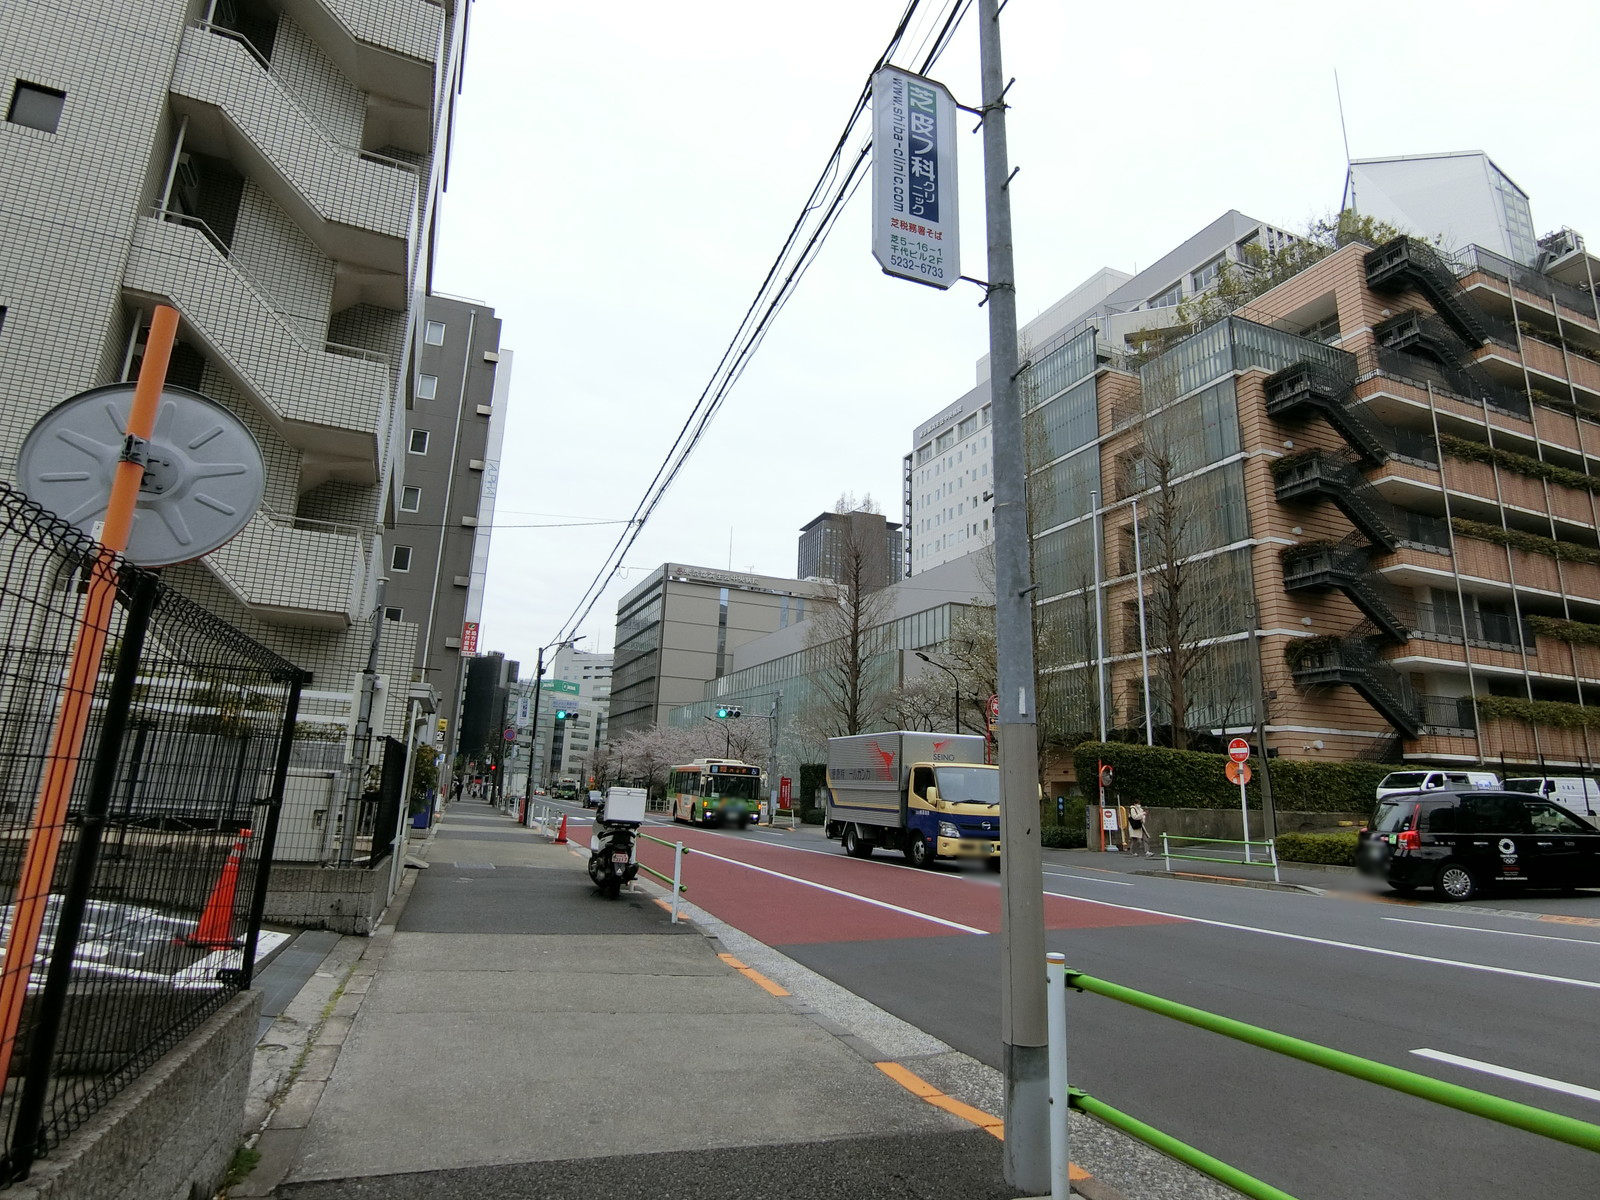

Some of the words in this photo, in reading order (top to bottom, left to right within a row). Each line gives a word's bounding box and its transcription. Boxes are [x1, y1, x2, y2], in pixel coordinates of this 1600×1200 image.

[893, 77, 906, 212] www.shiba-clinic.com
[909, 86, 936, 181] 芝皮フ科
[890, 217, 943, 241] 芝税務署そば
[890, 244, 943, 266] 千代ビル2F
[890, 254, 944, 279] 5232-6733
[932, 753, 955, 761] SEINO
